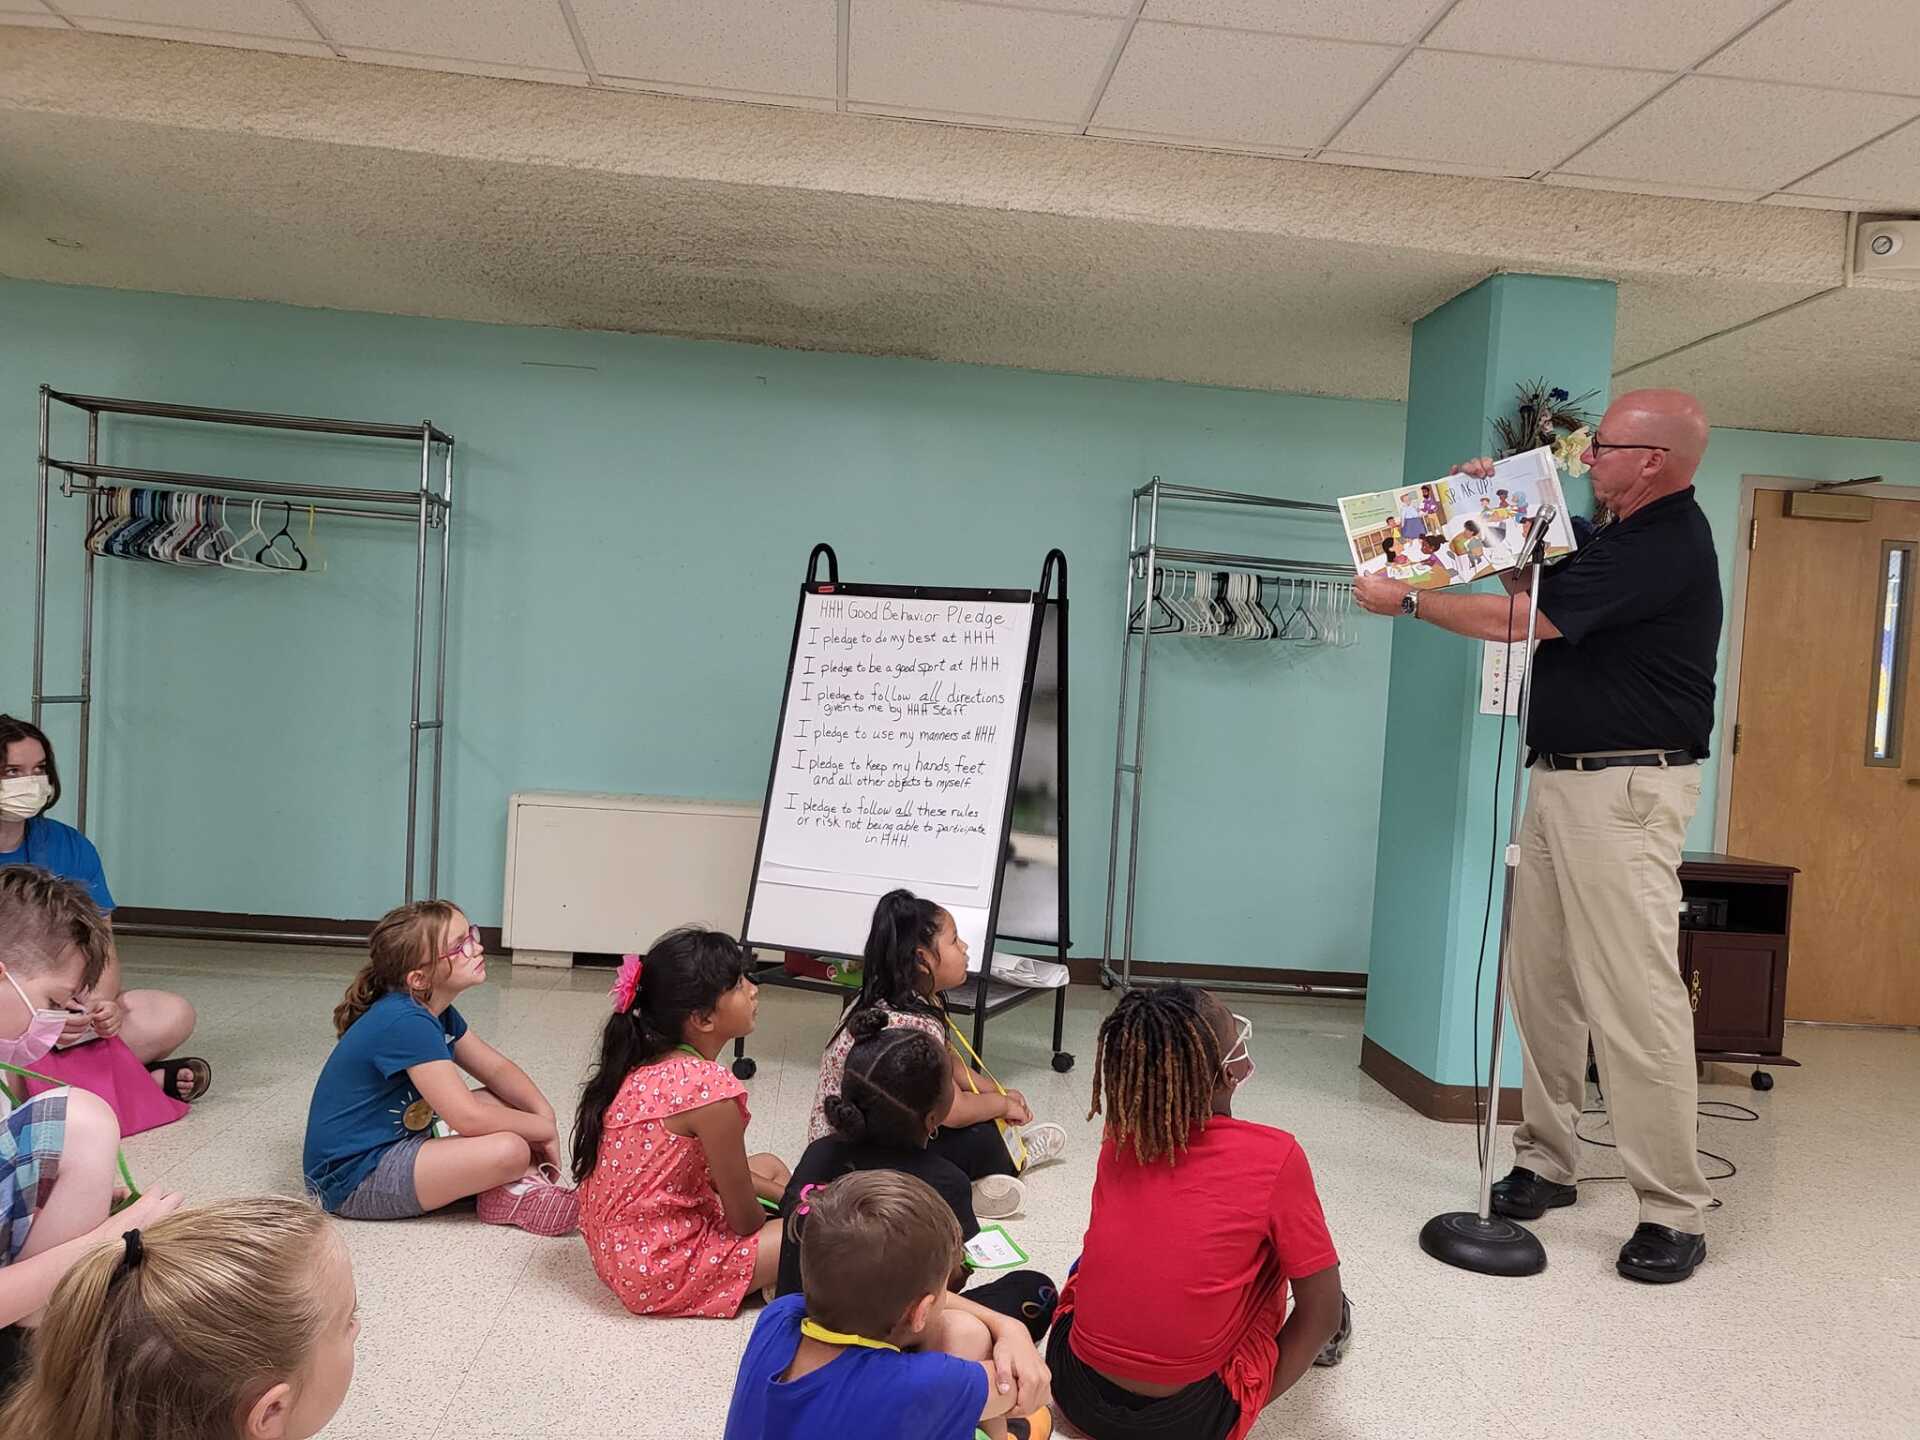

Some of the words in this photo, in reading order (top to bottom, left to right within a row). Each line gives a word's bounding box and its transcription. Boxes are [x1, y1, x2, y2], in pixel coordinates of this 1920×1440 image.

[1445, 480, 1476, 505] SPAK
[820, 599, 844, 619] HHH
[848, 600, 879, 620] Good
[882, 601, 940, 623] Behavior
[947, 604, 1006, 629] Pledge
[807, 626, 821, 644] I
[823, 627, 858, 651] pledge
[861, 632, 872, 643] to
[874, 628, 887, 643] do
[890, 635, 906, 650] my
[907, 628, 937, 643] best
[942, 632, 957, 643] at
[802, 655, 817, 675] I
[820, 659, 853, 678] pledge
[856, 660, 866, 672] to
[868, 653, 882, 673] be
[894, 657, 917, 679] good
[917, 658, 946, 676] sport
[949, 660, 963, 672] at
[799, 681, 815, 702] I
[817, 684, 851, 705] pledge
[853, 690, 865, 701] to
[871, 682, 911, 703] follow
[919, 680, 943, 705] all
[947, 680, 1005, 704] directions
[823, 703, 851, 717] given
[852, 703, 865, 713] to
[868, 704, 884, 713] me
[888, 703, 902, 722] by
[907, 703, 928, 716] HHH
[793, 719, 813, 738] I
[814, 720, 849, 748] pledge
[854, 725, 867, 739] to
[872, 730, 895, 741] use
[899, 732, 914, 749] my
[920, 730, 958, 741] manners
[961, 730, 971, 741] at
[791, 748, 808, 770] I
[808, 753, 845, 776] pledge
[850, 756, 862, 770] to
[892, 762, 911, 781] my
[813, 773, 836, 786] and
[838, 773, 853, 786] all
[856, 773, 886, 787] other
[887, 772, 921, 793] objects
[924, 776, 933, 788] to
[783, 792, 800, 810] I
[802, 795, 838, 819] pledge
[842, 801, 853, 814] to
[857, 795, 893, 816] follow
[894, 799, 914, 818] all
[917, 800, 948, 817] these
[951, 803, 980, 818] rules
[796, 815, 809, 826] or
[815, 815, 841, 829] risk
[844, 817, 864, 830] not
[866, 816, 894, 837] being
[895, 819, 920, 832] able
[922, 820, 934, 833] to
[864, 833, 878, 844] in
